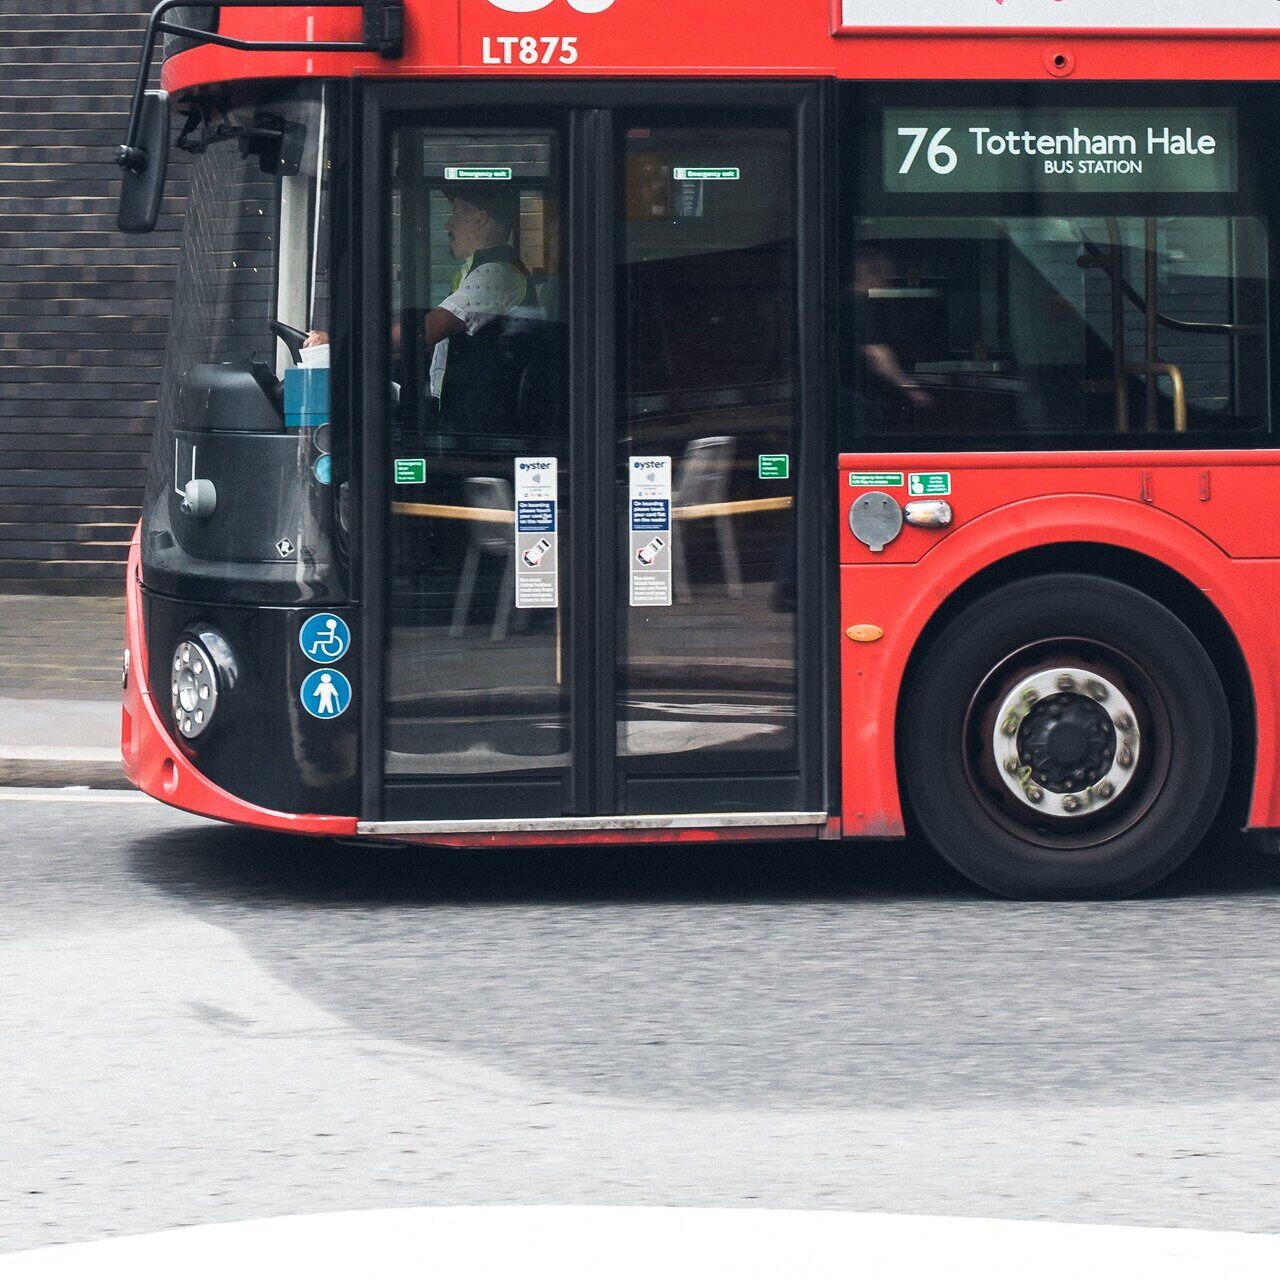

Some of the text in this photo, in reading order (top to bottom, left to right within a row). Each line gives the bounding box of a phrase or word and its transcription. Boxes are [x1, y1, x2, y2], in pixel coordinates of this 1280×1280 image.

[482, 36, 578, 65] LT875
[897, 127, 1216, 175] 76 Tottenham Hale
[1044, 159, 1143, 174] BUS STATION
[519, 462, 552, 471] oyster
[634, 461, 666, 470] oyster
